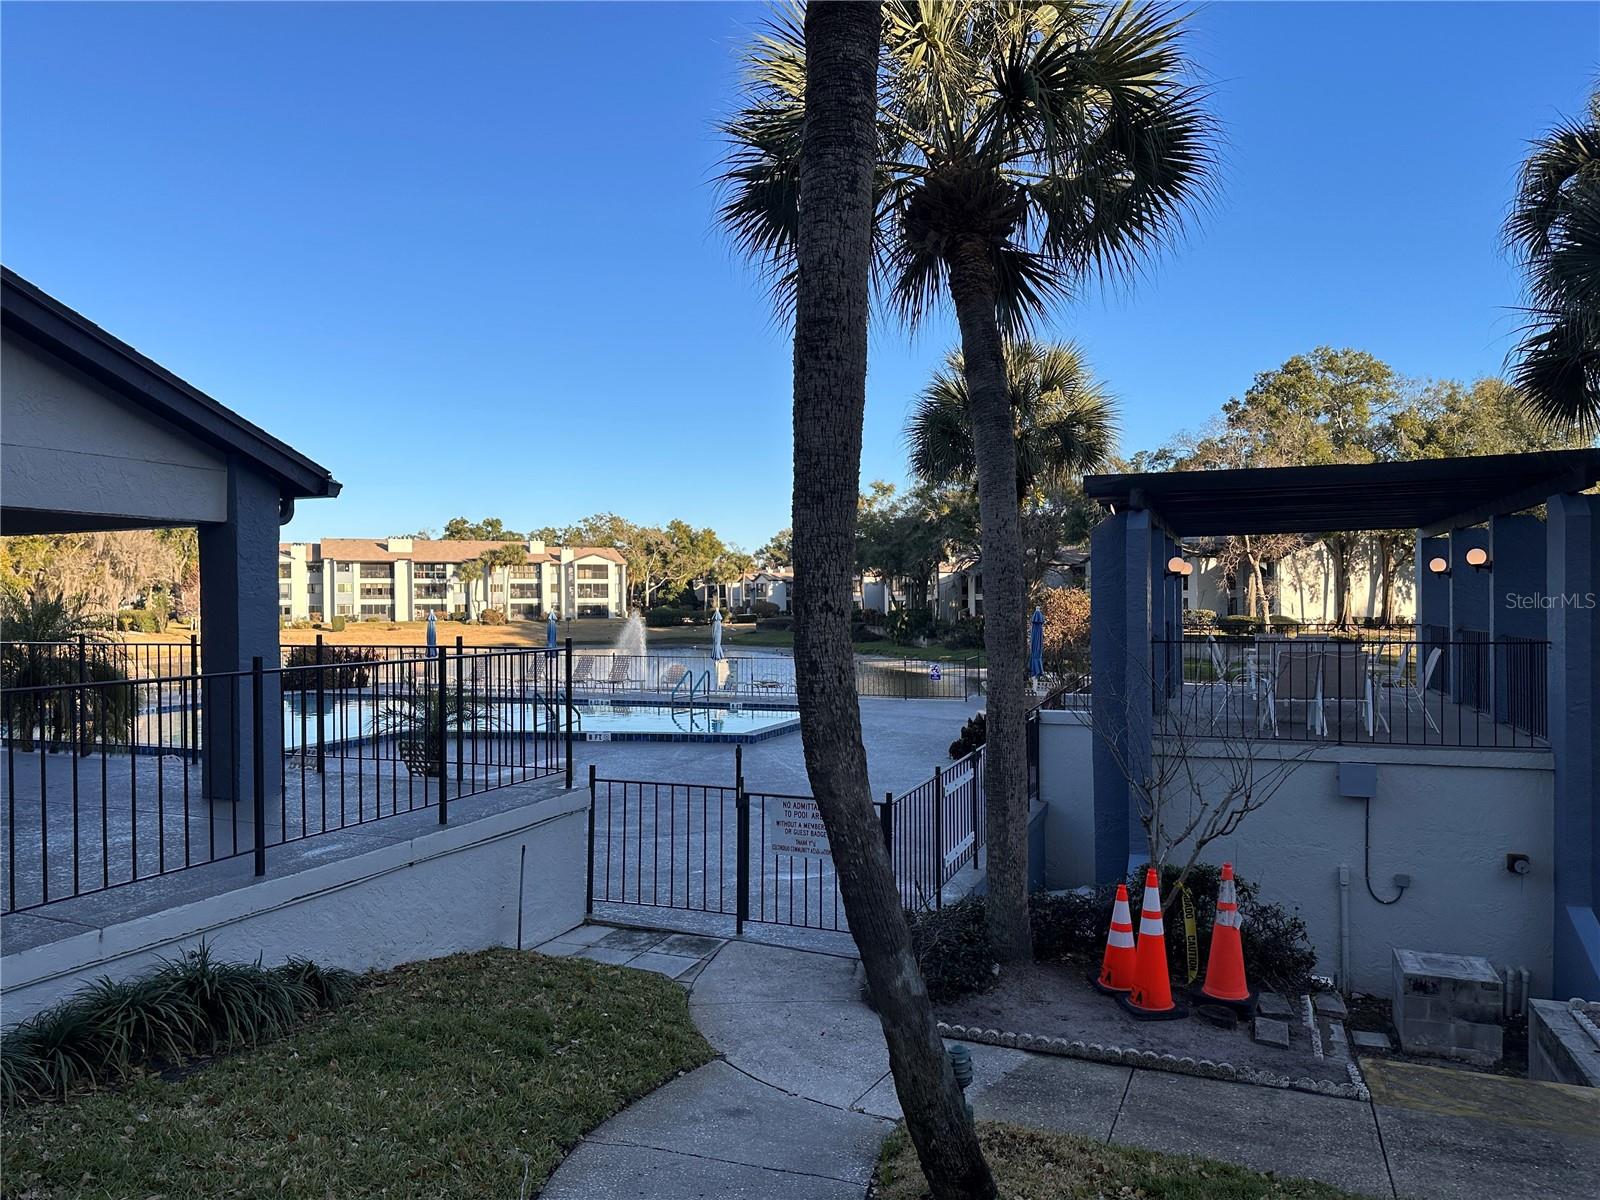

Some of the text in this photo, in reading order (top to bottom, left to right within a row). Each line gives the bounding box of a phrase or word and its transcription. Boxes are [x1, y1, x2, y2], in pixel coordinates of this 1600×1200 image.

[782, 801, 818, 811] NO ADMITTA
[784, 810, 792, 818] TO
[811, 812, 823, 820] AR
[776, 820, 797, 829] WITHOUT
[793, 829, 809, 837] GUEST
[1187, 935, 1198, 971] CAUTION
